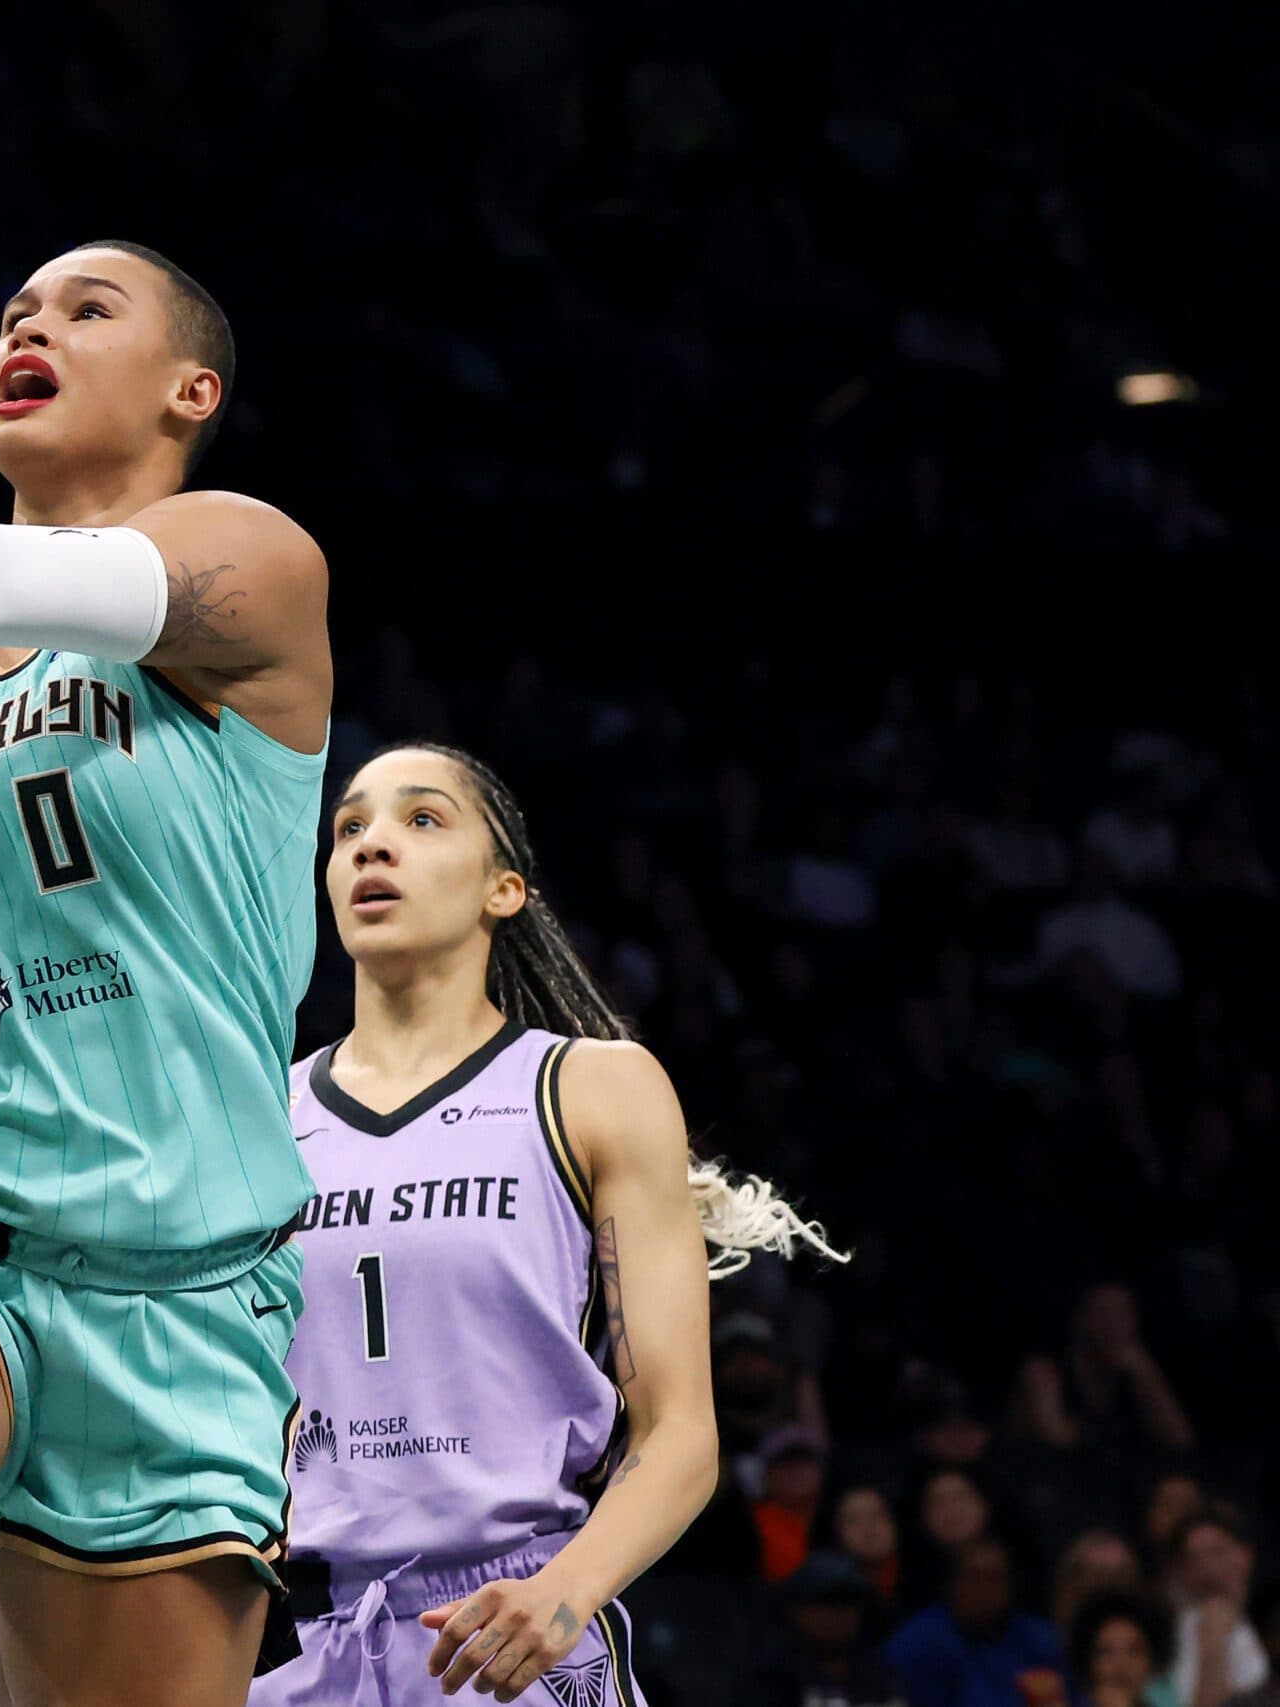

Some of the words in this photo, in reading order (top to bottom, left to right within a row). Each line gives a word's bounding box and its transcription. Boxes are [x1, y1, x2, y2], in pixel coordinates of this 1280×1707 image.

[11, 766, 102, 896] 0
[16, 950, 121, 989] Liberty
[24, 972, 135, 1020] Mutual
[467, 1104, 529, 1121] freedom
[389, 1176, 519, 1222] STATE
[351, 1251, 390, 1364] 1
[348, 1415, 409, 1437] KAISER
[350, 1437, 472, 1460] PERMANENTE
